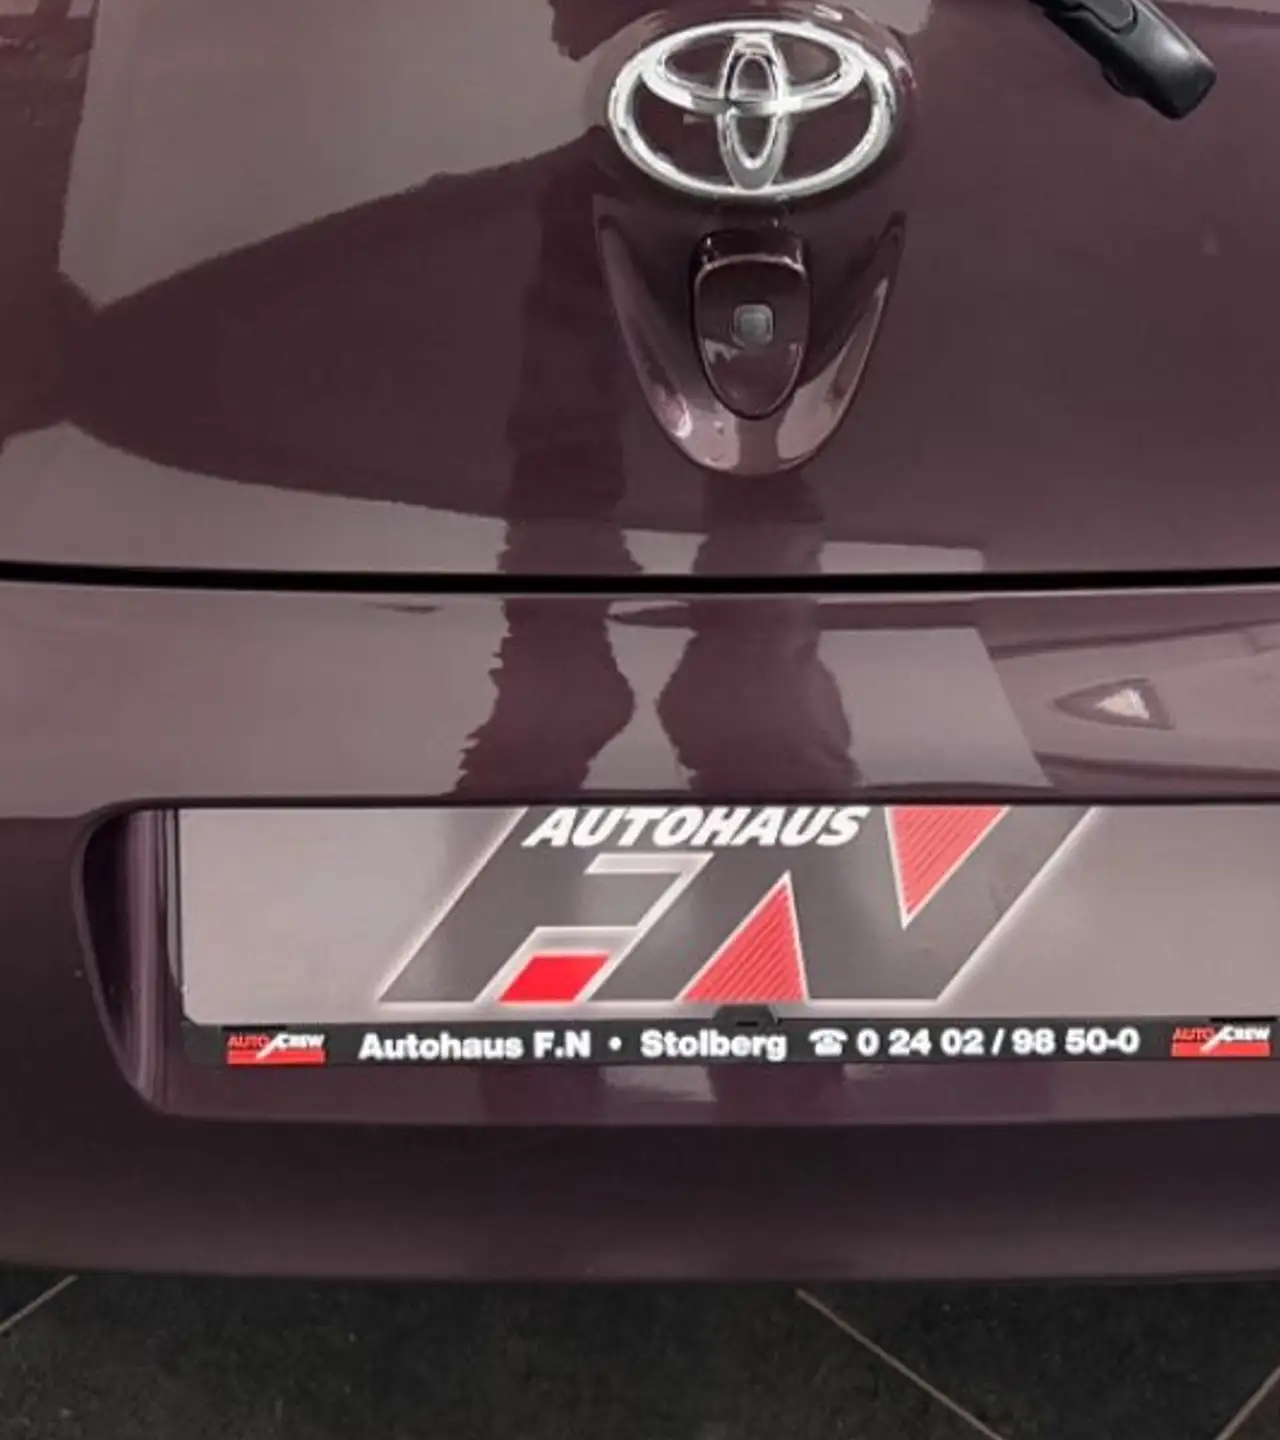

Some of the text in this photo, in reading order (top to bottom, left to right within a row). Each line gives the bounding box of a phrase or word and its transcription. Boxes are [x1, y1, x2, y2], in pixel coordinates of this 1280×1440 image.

[523, 806, 872, 847] AUTOHAUS
[358, 1032, 525, 1059] Autohaus
[533, 1030, 592, 1058] F.N
[640, 1028, 787, 1062] Stolberg
[856, 1028, 880, 1056] 0
[888, 1028, 932, 1056] 24
[940, 1027, 984, 1056] 02
[1010, 1026, 1055, 1055] 98
[1064, 1026, 1141, 1054] 50-0
